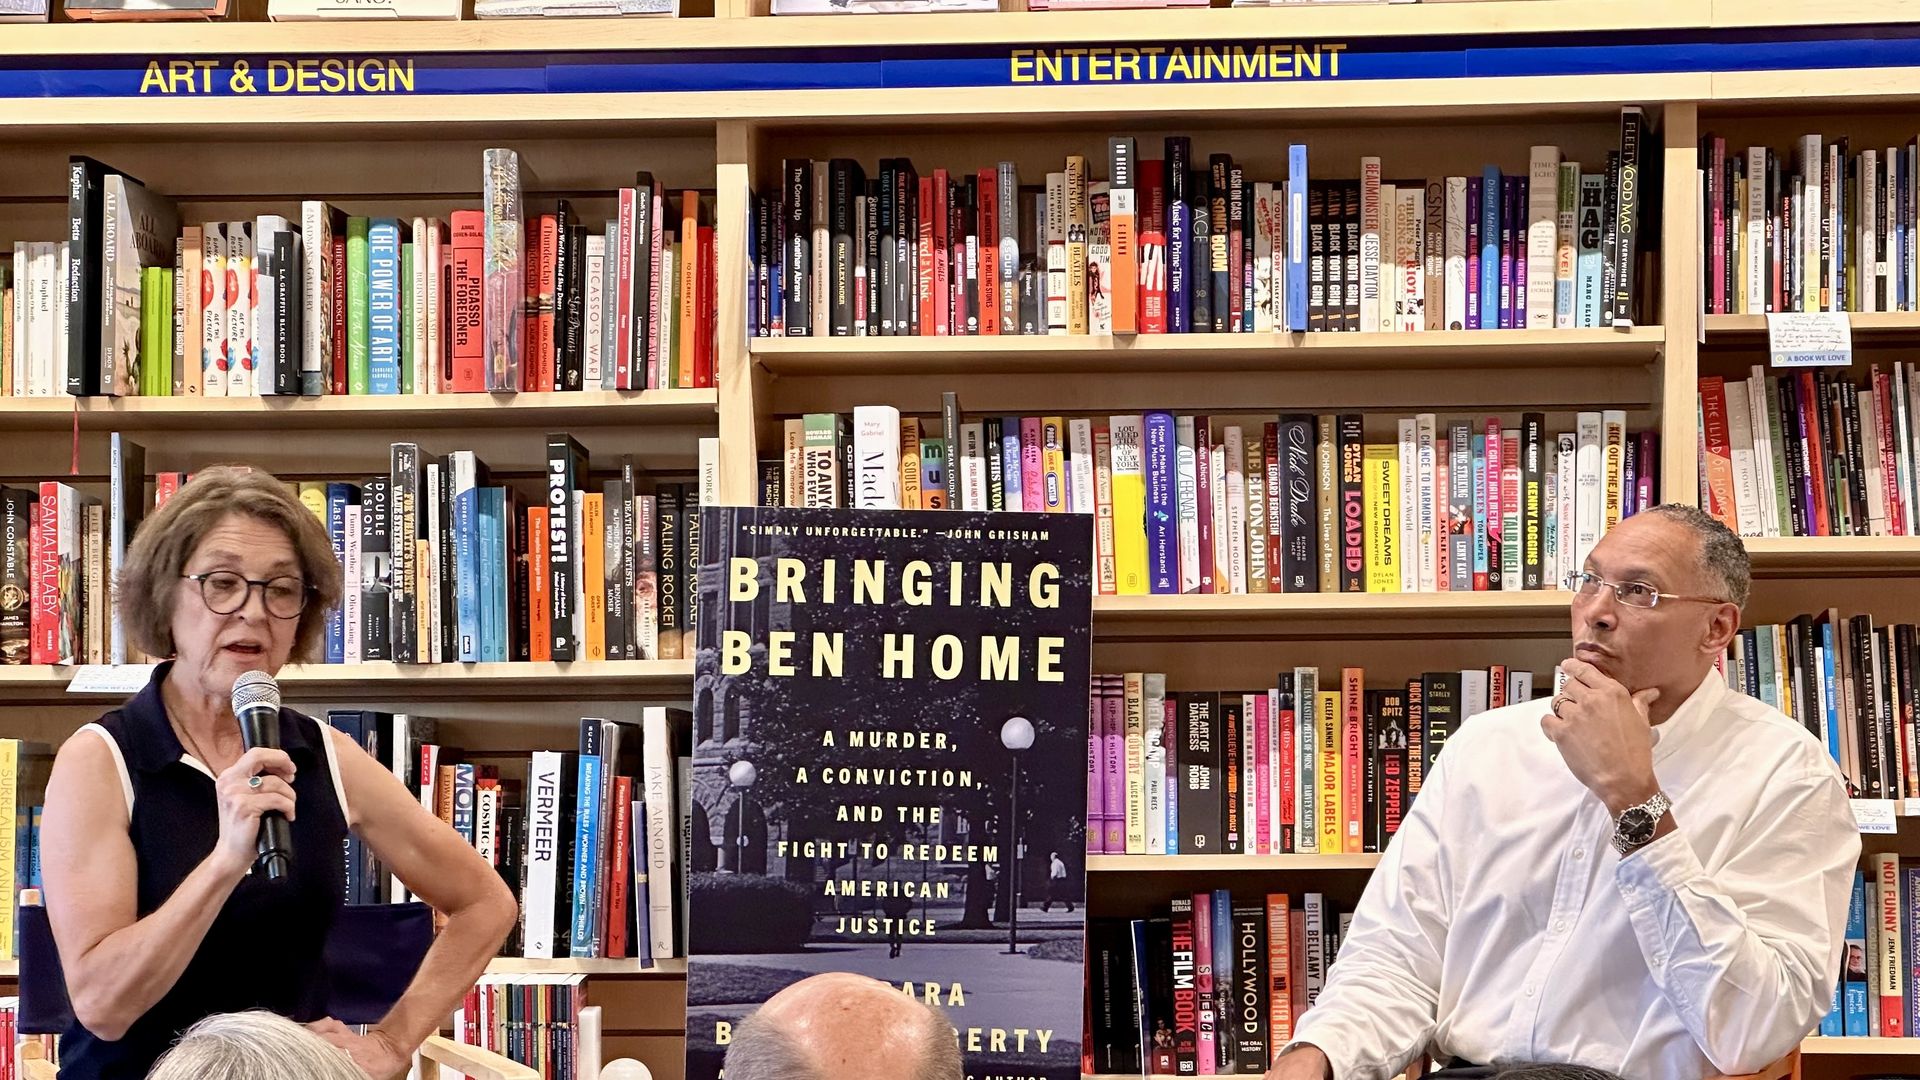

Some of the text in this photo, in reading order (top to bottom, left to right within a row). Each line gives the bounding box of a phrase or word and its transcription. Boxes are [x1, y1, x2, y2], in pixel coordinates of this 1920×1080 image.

[140, 58, 414, 93] ART & DESIGN
[1010, 44, 1347, 82] ENTERTAINMENT
[106, 192, 116, 213] ALL
[1428, 182, 1442, 229] CSNY
[1620, 122, 1636, 287] FLEETWOOD MAC EVERYWHERE
[1752, 153, 1761, 234] JOHN ASHBERY
[71, 166, 81, 302] Kaphar Betts Redaction
[106, 214, 116, 262] ABOARD
[542, 224, 552, 285] Thunderclap
[793, 167, 802, 302] The Come Up Jonathan Abrams
[1211, 198, 1228, 271] SONIC BOOM
[1365, 164, 1378, 299] BEAUMONSTER JESSE DAYTON
[1822, 218, 1830, 260] UP LATE
[1073, 246, 1081, 286] BEATLES
[1346, 223, 1358, 305] BLACK TOOTH GRIN
[40, 279, 49, 312] Raphael
[371, 226, 394, 364] THE POWER OF ART
[456, 259, 468, 346] THE FOREIGNER
[469, 277, 480, 327] PICASSO
[588, 262, 600, 374] PICASSO'S WAR
[1708, 396, 1718, 416] THE
[1159, 426, 1168, 442] How
[1159, 444, 1168, 452] to
[1709, 422, 1721, 453] ILIAD
[1151, 428, 1160, 503] New Music Business
[1159, 454, 1168, 473] Make
[1344, 444, 1352, 483] JONES
[1352, 444, 1361, 483] DYLAN
[1712, 458, 1724, 471] OF
[364, 483, 372, 536] VISION
[375, 483, 385, 536] DOUBLE
[550, 459, 567, 562] PROTEST!
[1159, 494, 1168, 505] the
[1248, 442, 1265, 579] ME ELTON JOHN
[1382, 461, 1391, 565] SWEET DREAMS
[1504, 438, 1517, 573] VIBRATE HIGHER TALIB KWELI
[1527, 482, 1537, 565] KENNY LOGGINS
[6, 498, 14, 578] JOHN CONSTABLE
[42, 496, 57, 616] SAMIA HALABY
[624, 500, 632, 587] DEATHS OF ARTISTS
[988, 530, 1048, 541] GRISHAM
[1344, 490, 1361, 572] LOADED
[347, 513, 357, 644] Funny Weather Olivia Laing
[662, 514, 674, 627] FALLING ROCKET
[729, 557, 1060, 609] BRINGING
[721, 631, 1064, 682] BEN HOME
[822, 731, 957, 752] A MURDER,
[1128, 681, 1140, 774] MY BLACK COUNTRY
[1189, 703, 1199, 750] DARKNESS
[1200, 702, 1209, 752] THE ART OF
[1325, 698, 1333, 748] KELEFA SANNEH
[796, 768, 983, 789] A CONVICTION,
[1189, 765, 1199, 790] ROBB
[1200, 765, 1209, 789] JOHN
[1324, 750, 1335, 835] MAJOR LABELS
[1386, 754, 1400, 832] LED ZEPPELIN
[536, 772, 555, 862] VERMEER
[650, 766, 665, 869] JAKE ARNOLD
[836, 806, 940, 823] AND THE
[778, 842, 997, 863] FIGHT TO REDEEM
[824, 881, 948, 898] AMERICAN
[836, 918, 936, 936] JUSTICE
[1308, 903, 1320, 979] BILL BELLAMY
[1883, 862, 1896, 990] NOT FUNNY JENA FRIEDMAN
[1173, 920, 1194, 1033] THE FILM BOOK
[1242, 923, 1257, 1033] HOLLYWOOD
[957, 1028, 1053, 1054] ERTY
